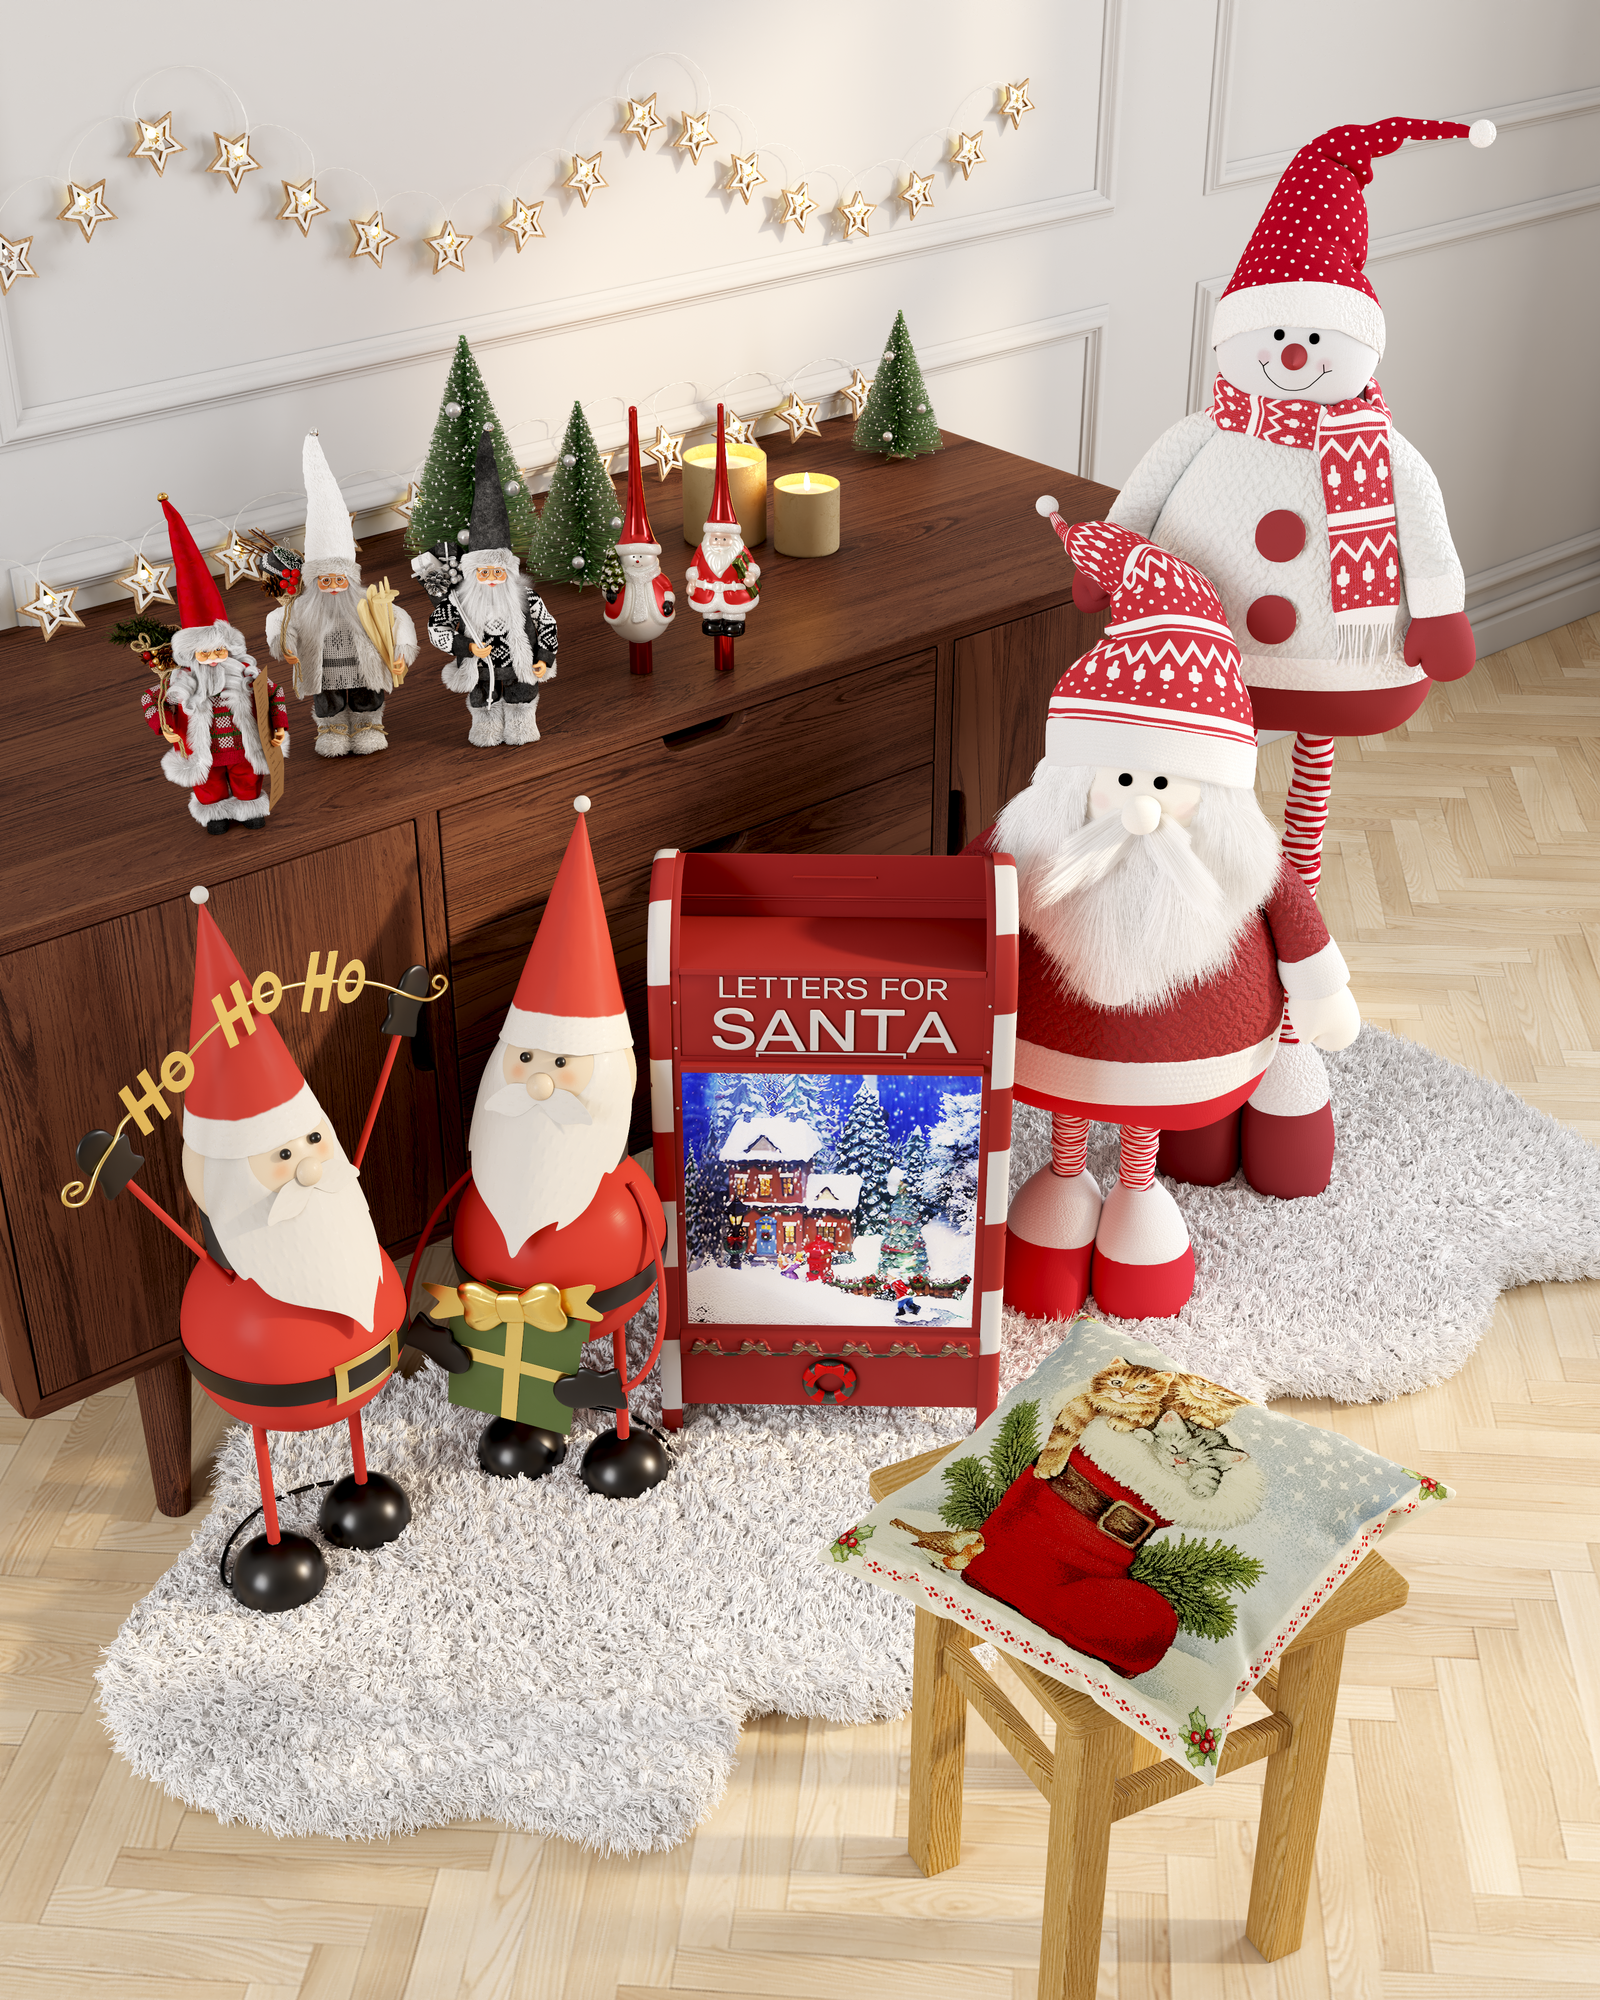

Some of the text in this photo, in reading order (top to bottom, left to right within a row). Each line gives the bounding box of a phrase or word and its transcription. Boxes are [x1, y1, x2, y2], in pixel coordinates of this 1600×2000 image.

[718, 976, 949, 1002] LETTERS FOR
[711, 1007, 958, 1054] SANTA
